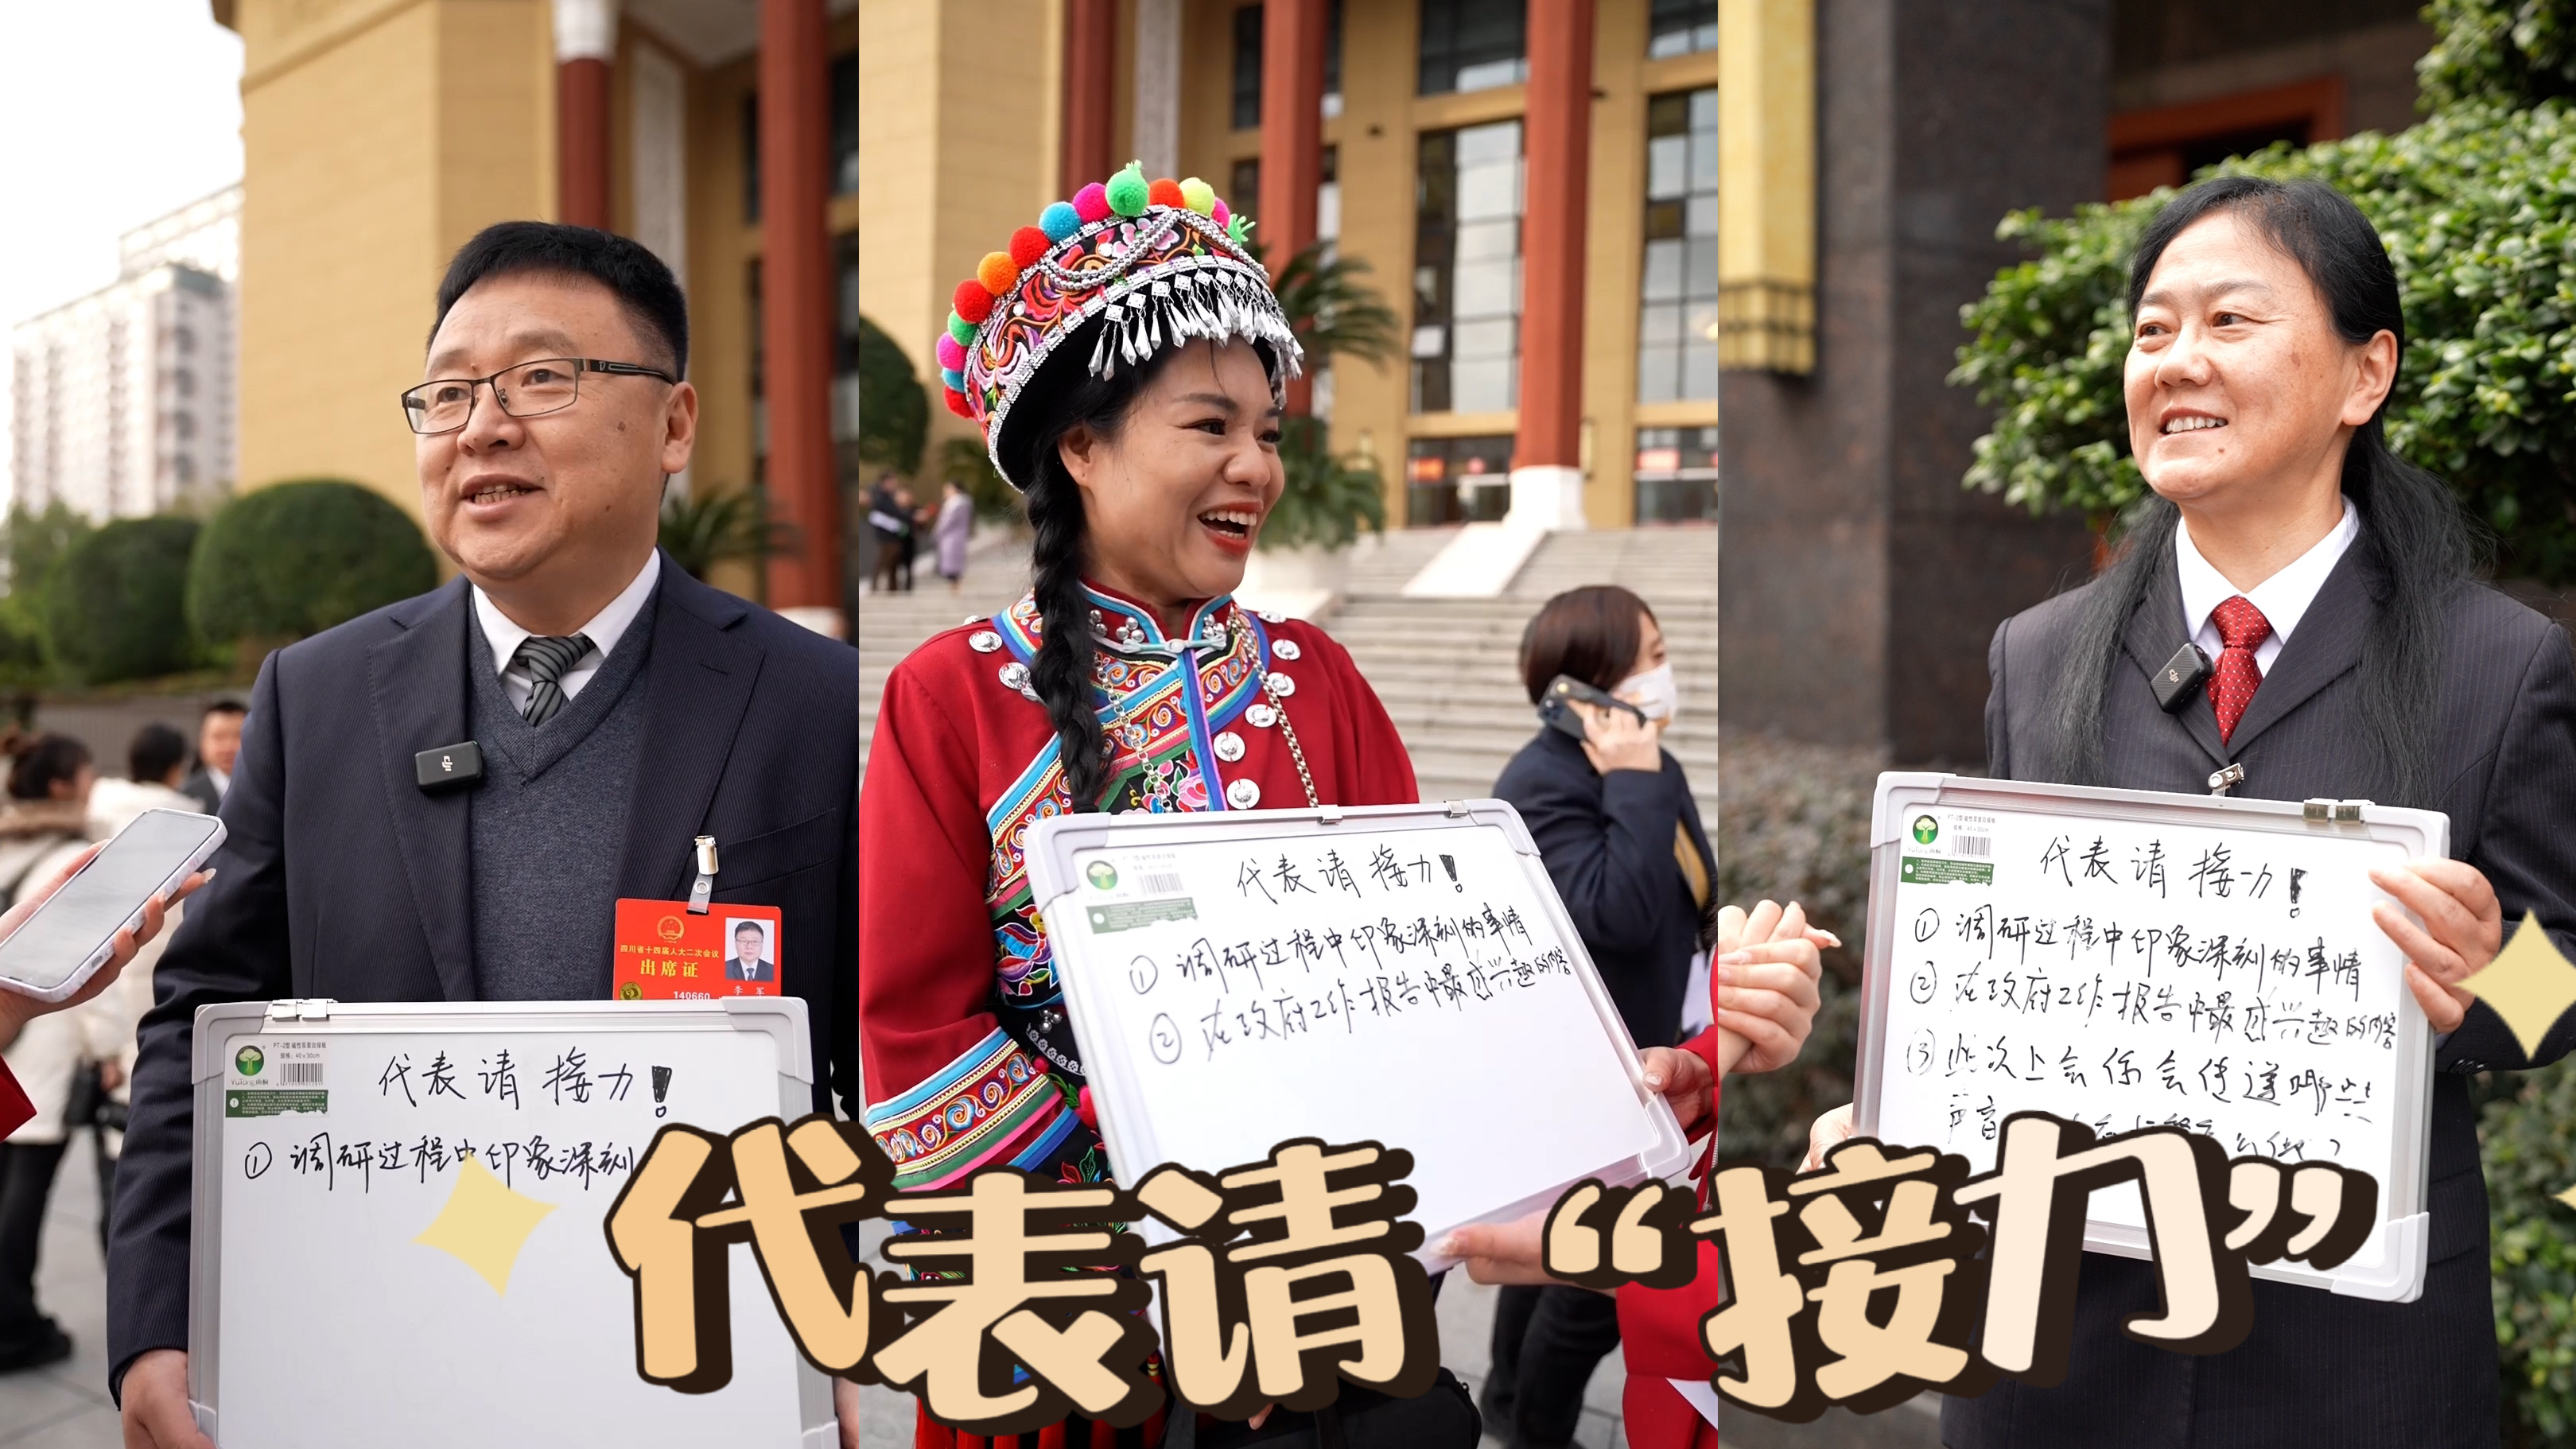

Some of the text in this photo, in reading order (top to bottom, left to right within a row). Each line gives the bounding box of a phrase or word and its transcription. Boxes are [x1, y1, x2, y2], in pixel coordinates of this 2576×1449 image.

[620, 944, 719, 958] 四川省十四届人大二次会议
[640, 958, 698, 978] 出席证
